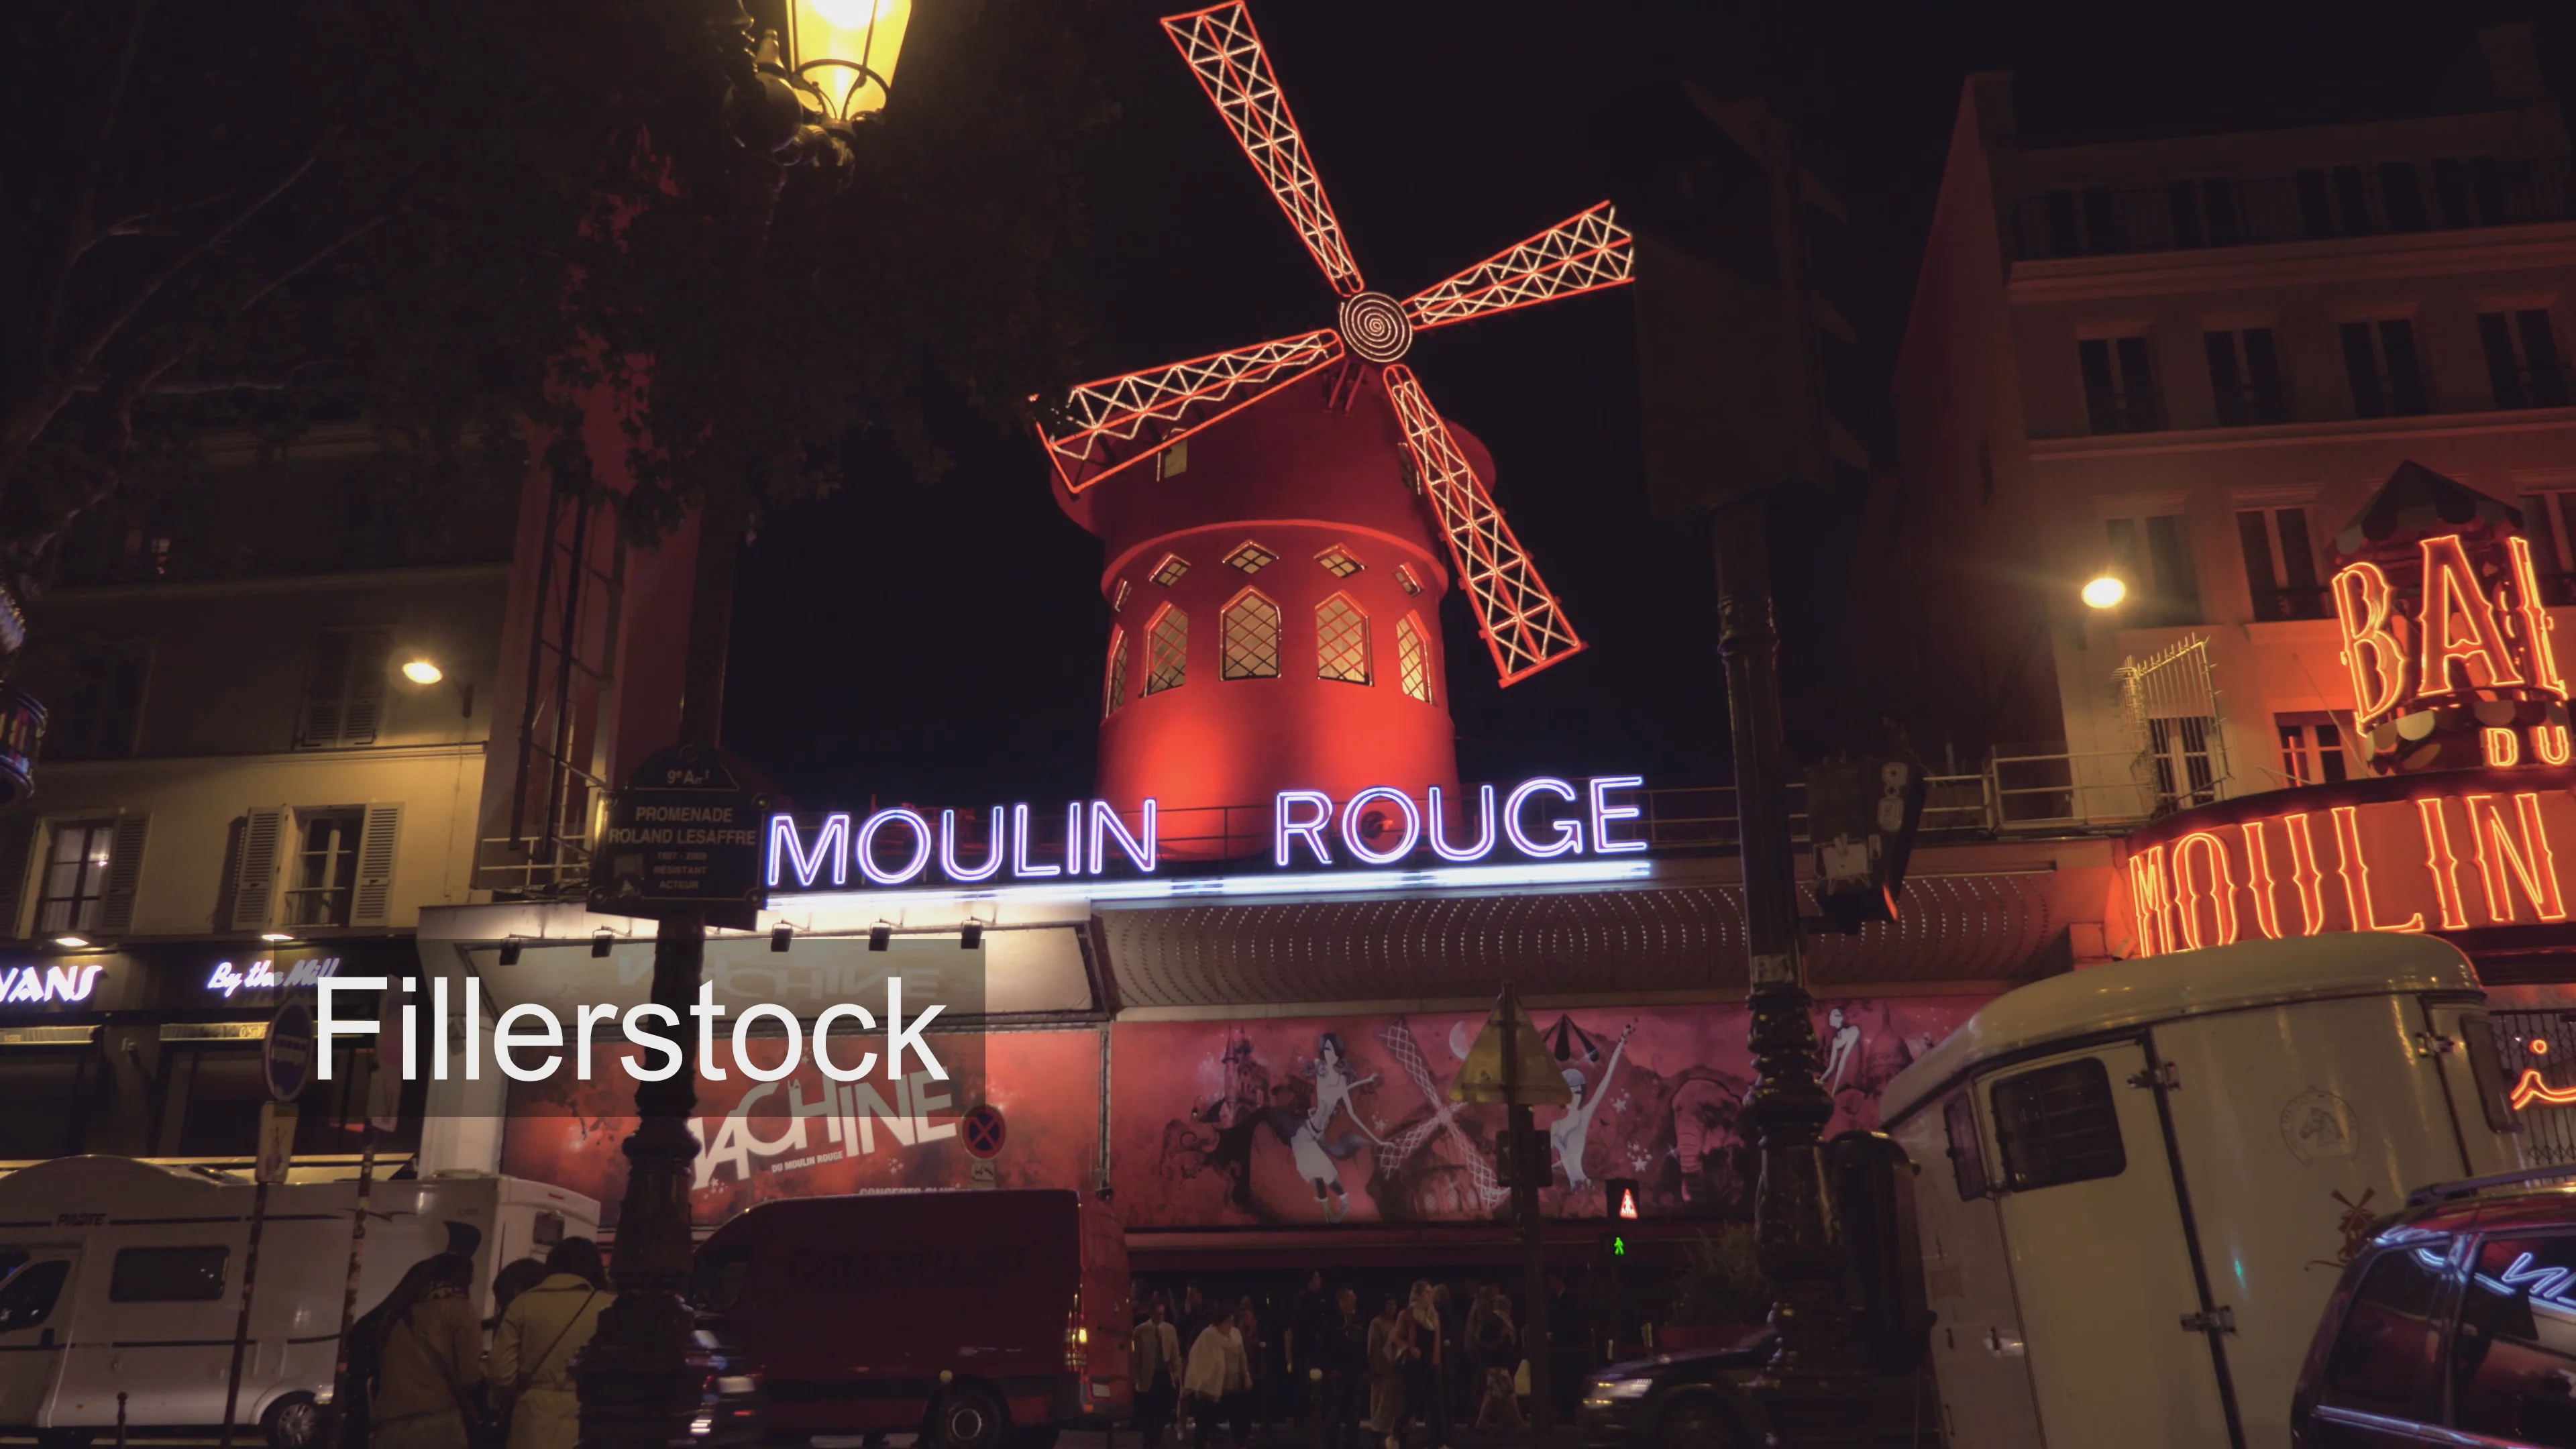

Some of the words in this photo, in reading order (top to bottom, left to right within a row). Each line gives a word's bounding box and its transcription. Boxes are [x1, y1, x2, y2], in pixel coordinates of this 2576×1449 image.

[2485, 725, 2570, 767] DU
[635, 806, 734, 823] PROMENADE
[608, 828, 674, 844] ROLAND
[676, 829, 757, 846] LESAFFRE
[767, 797, 1158, 887] MOULIN
[1275, 774, 1649, 866] ROUGE
[659, 879, 699, 890] ACTEUR
[2129, 792, 2567, 959] MOULIN
[207, 961, 243, 998] By
[244, 959, 284, 988] the
[771, 1163, 784, 1174] DU
[784, 1156, 816, 1171] MOULIN
[816, 1150, 844, 1163] ROUGE
